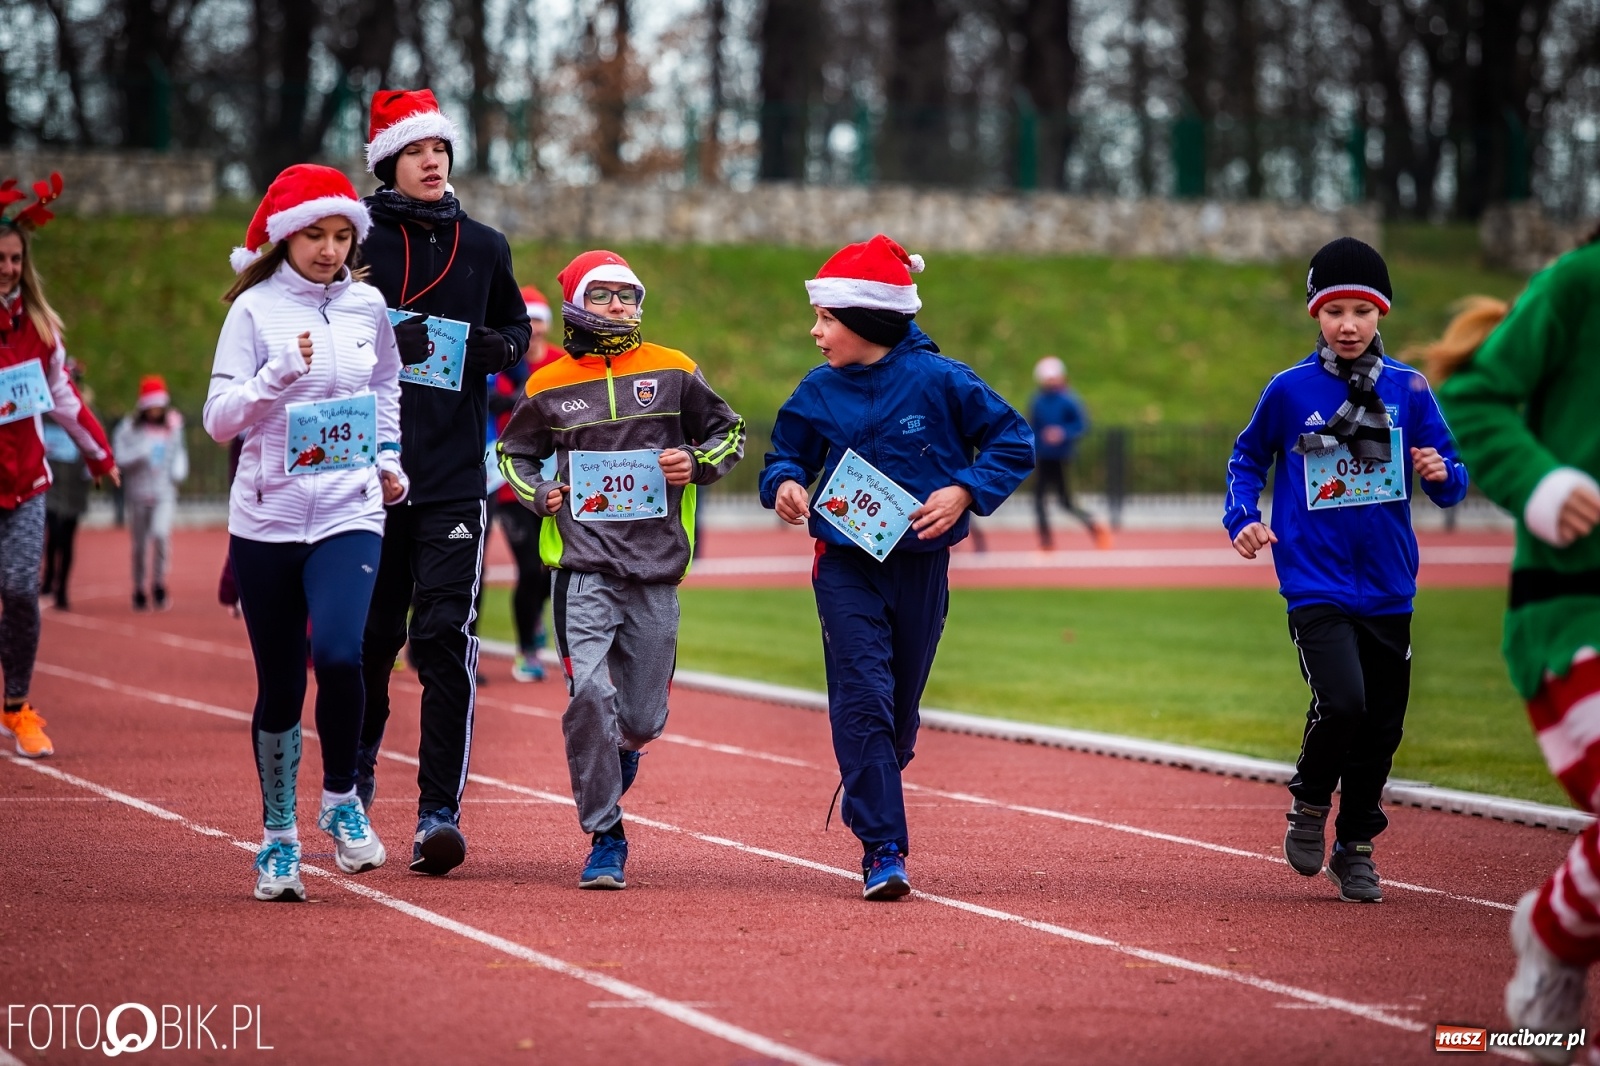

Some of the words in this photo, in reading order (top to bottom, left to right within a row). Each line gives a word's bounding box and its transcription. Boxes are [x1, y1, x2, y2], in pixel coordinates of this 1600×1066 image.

[11, 383, 29, 399] 171
[320, 422, 351, 444] 143
[1336, 458, 1375, 476] 032
[602, 474, 634, 492] 210
[851, 489, 881, 517] 186
